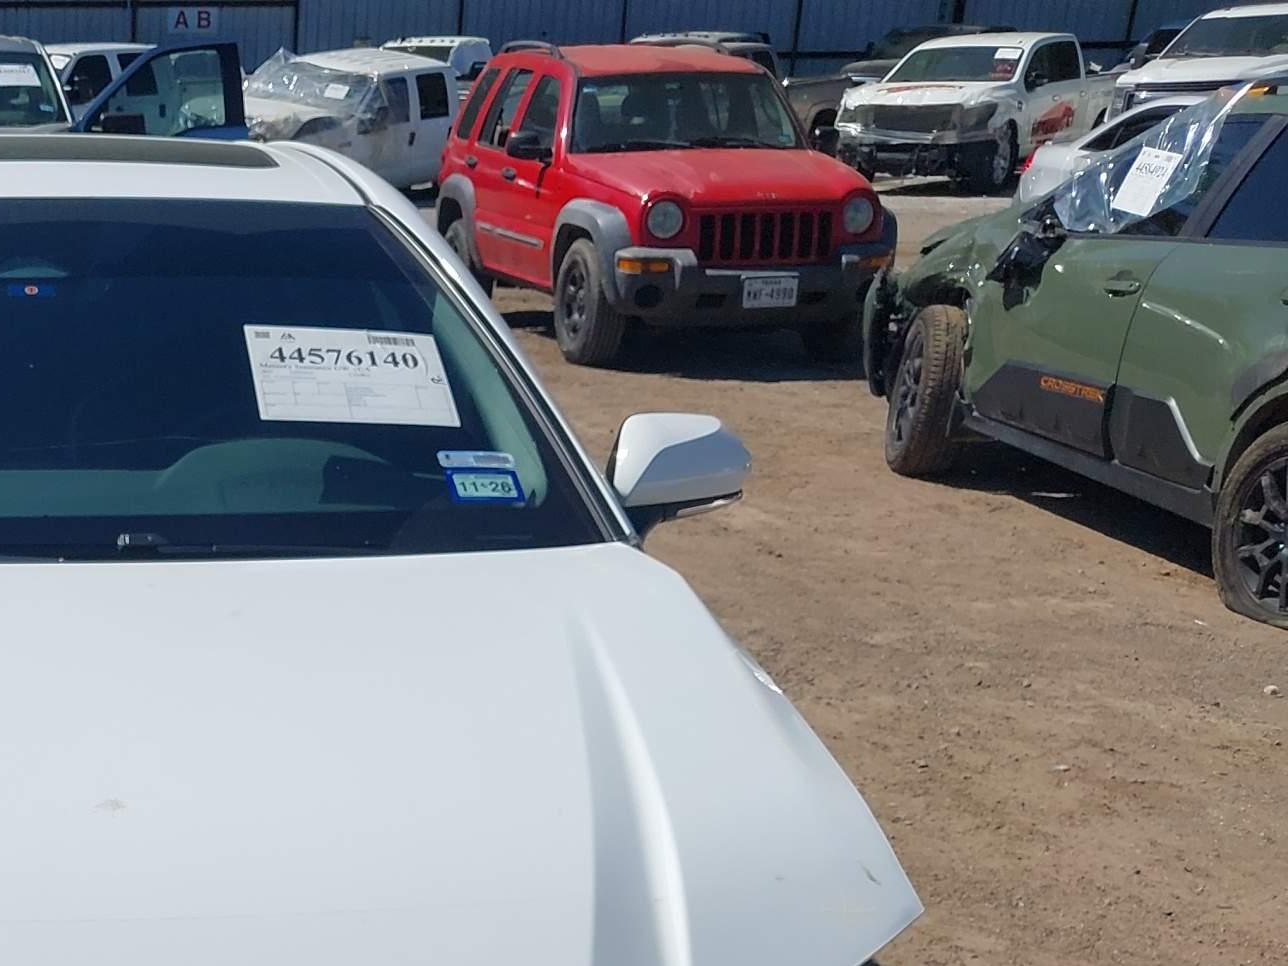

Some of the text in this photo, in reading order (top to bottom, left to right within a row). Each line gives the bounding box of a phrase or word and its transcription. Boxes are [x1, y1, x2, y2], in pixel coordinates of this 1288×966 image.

[174, 10, 211, 29] A B
[269, 346, 419, 370] 44576140
